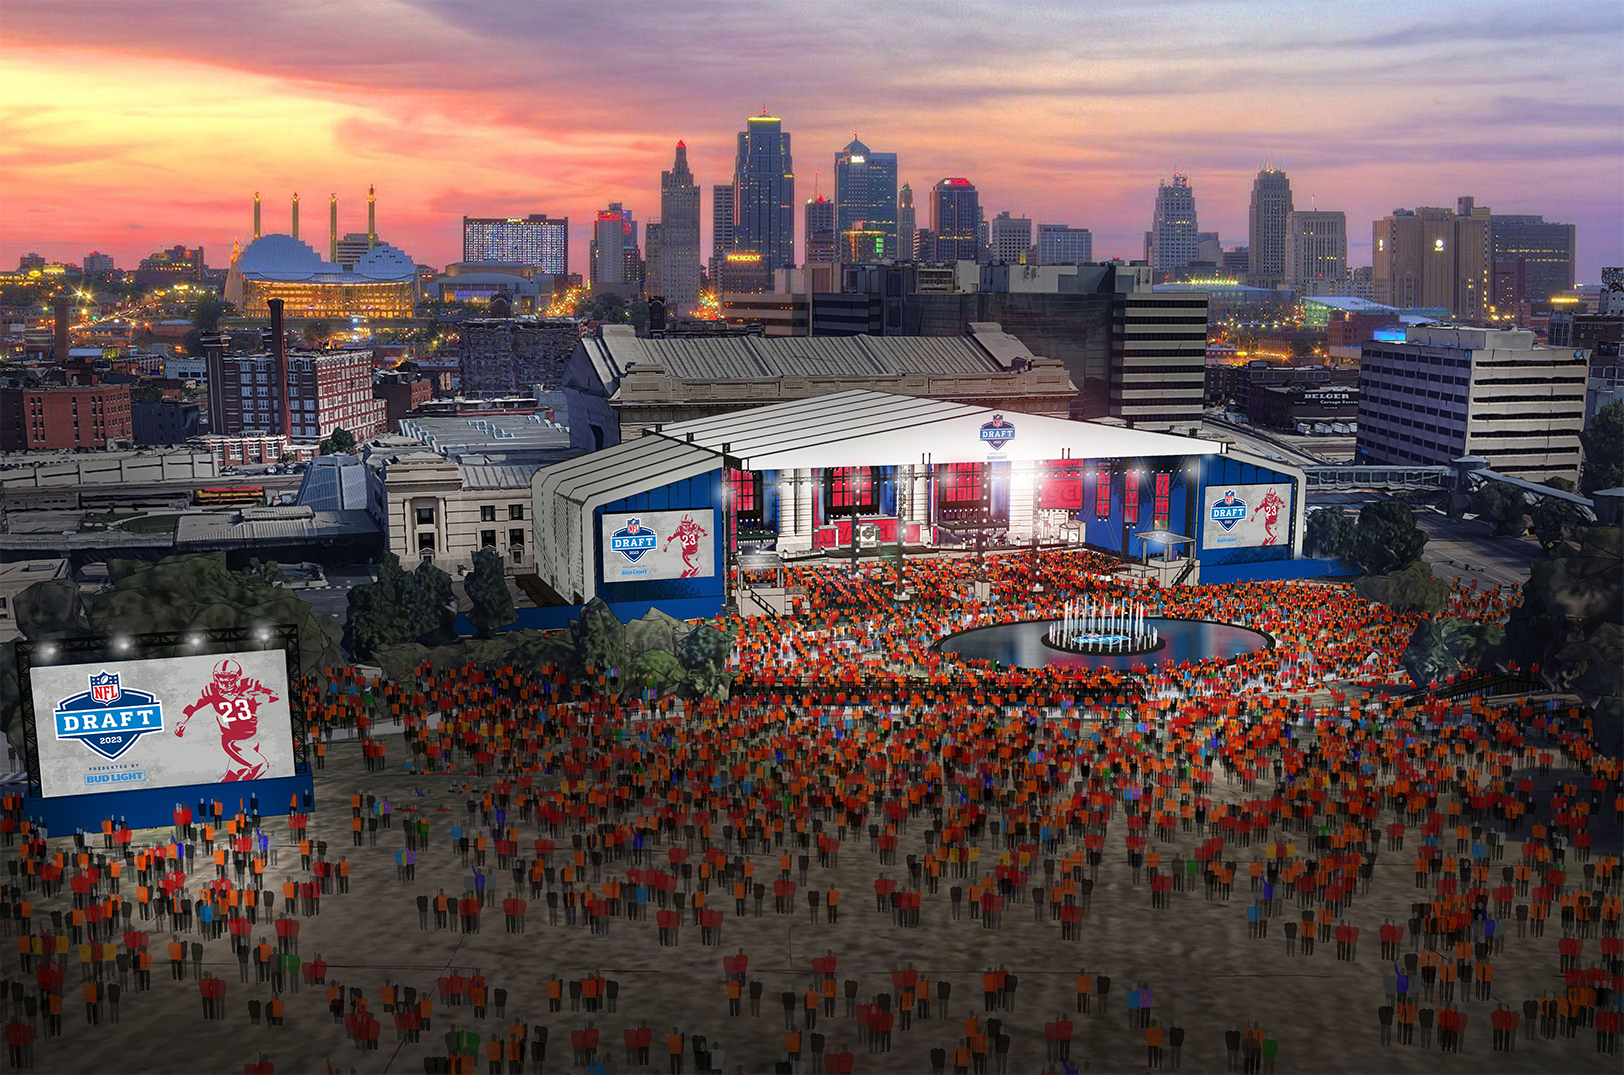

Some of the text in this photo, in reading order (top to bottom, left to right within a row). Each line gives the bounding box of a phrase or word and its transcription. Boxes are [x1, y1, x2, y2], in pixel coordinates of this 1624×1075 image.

[982, 430, 1014, 438] DRAFT
[1213, 508, 1244, 517] DRAFT
[1266, 505, 1277, 517] 23
[628, 524, 639, 533] NFL
[615, 538, 653, 548] DRAFT
[682, 534, 696, 546] 23
[93, 684, 118, 701] NFL
[218, 699, 252, 723] 23
[64, 709, 154, 732] DRAFT
[99, 735, 123, 745] 2023
[86, 771, 144, 784] BUD LIGHT
